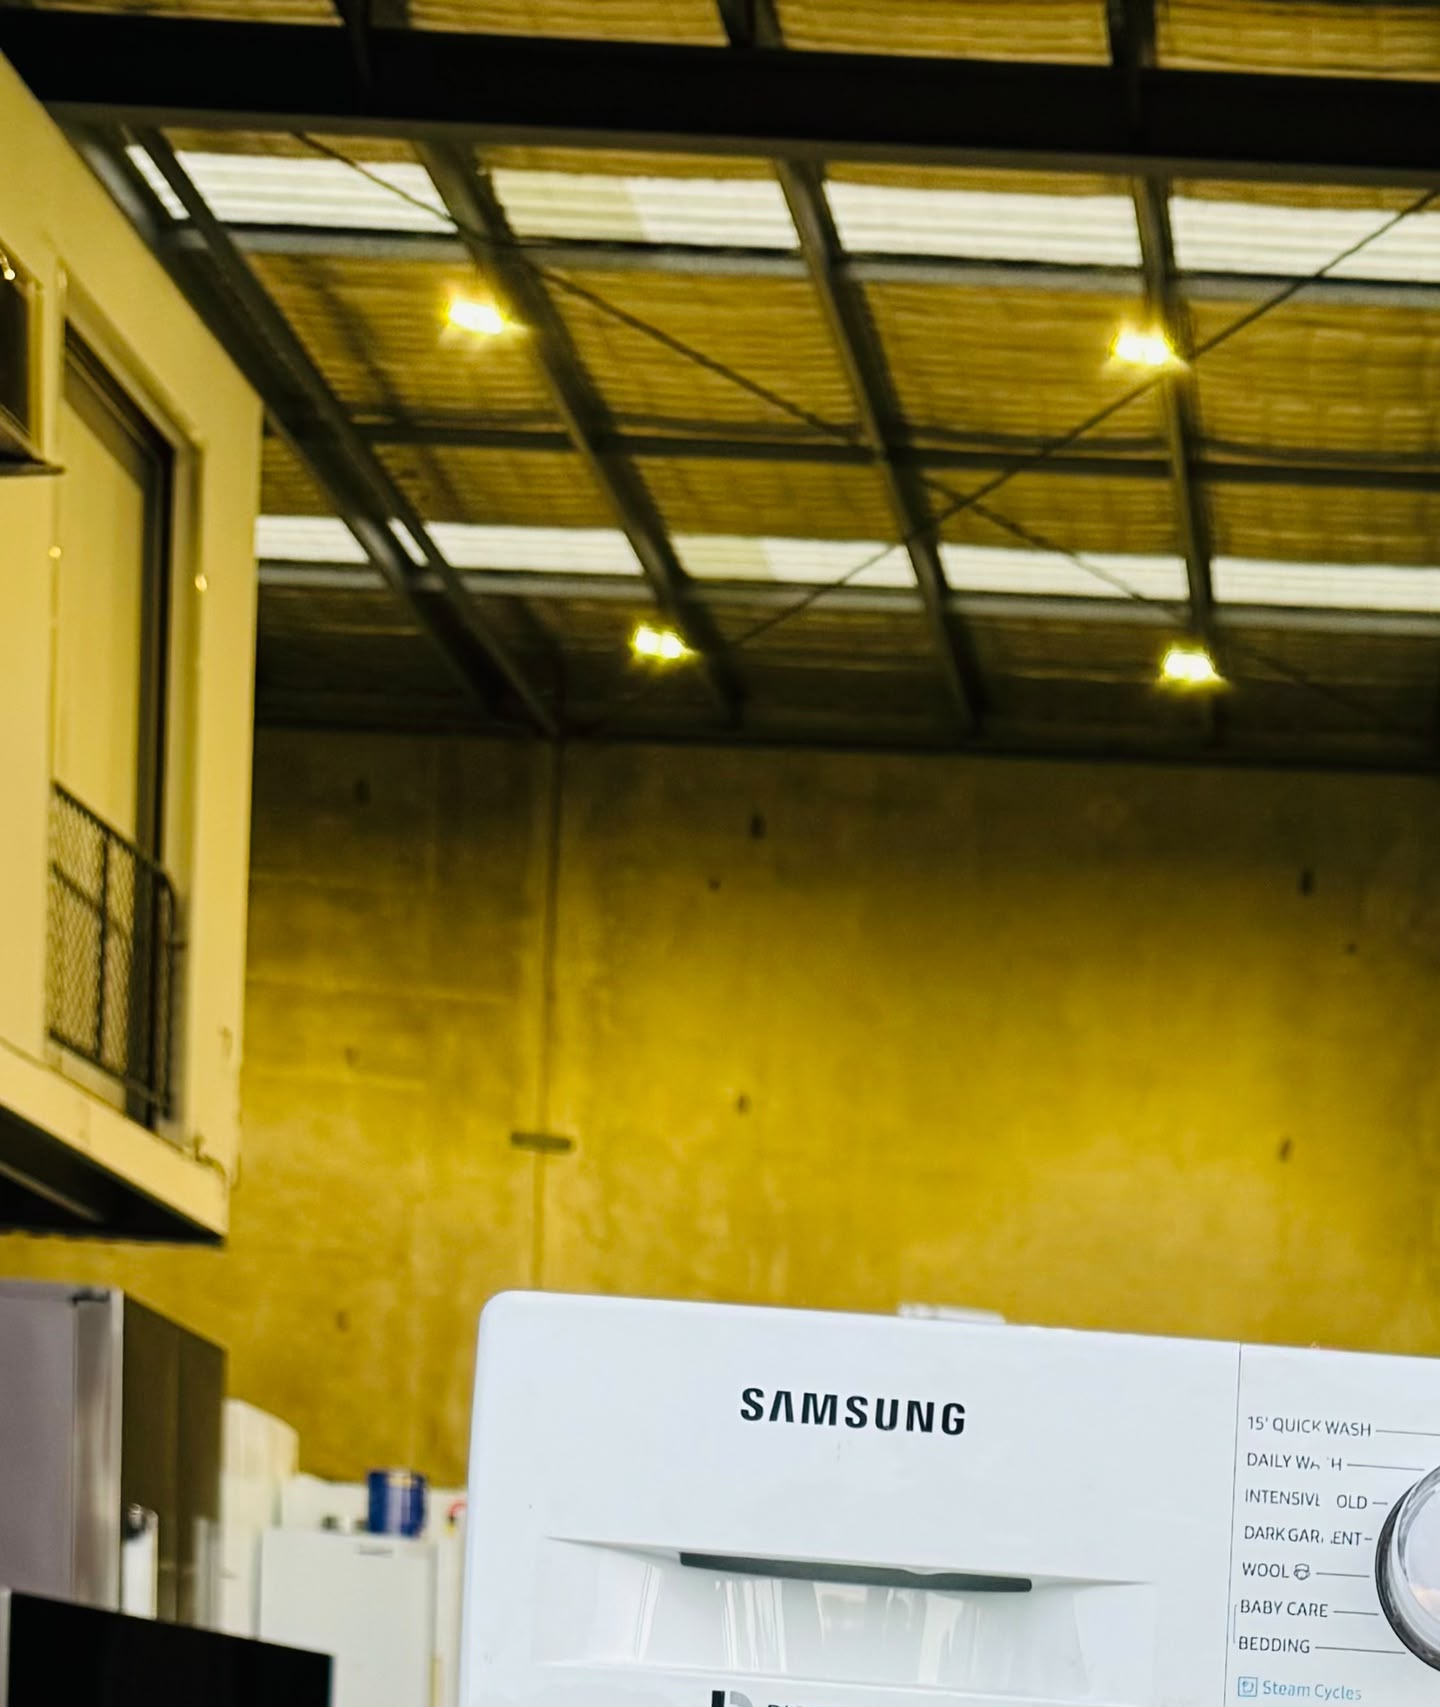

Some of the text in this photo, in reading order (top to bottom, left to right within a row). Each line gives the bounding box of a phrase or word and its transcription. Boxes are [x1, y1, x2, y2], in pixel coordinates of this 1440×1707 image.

[740, 1388, 965, 1435] SAMSUNG
[1272, 1417, 1321, 1433] QUICK
[1325, 1420, 1371, 1437] WASH
[1247, 1452, 1292, 1468] DAILY
[1336, 1494, 1368, 1509] OLD
[1244, 1525, 1362, 1546] DARK GARENT
[1242, 1562, 1290, 1578] WOOL
[1240, 1599, 1328, 1618] BABY CARE
[1239, 1636, 1310, 1653] BEDDING
[1262, 1680, 1362, 1701] Steam Cycles
